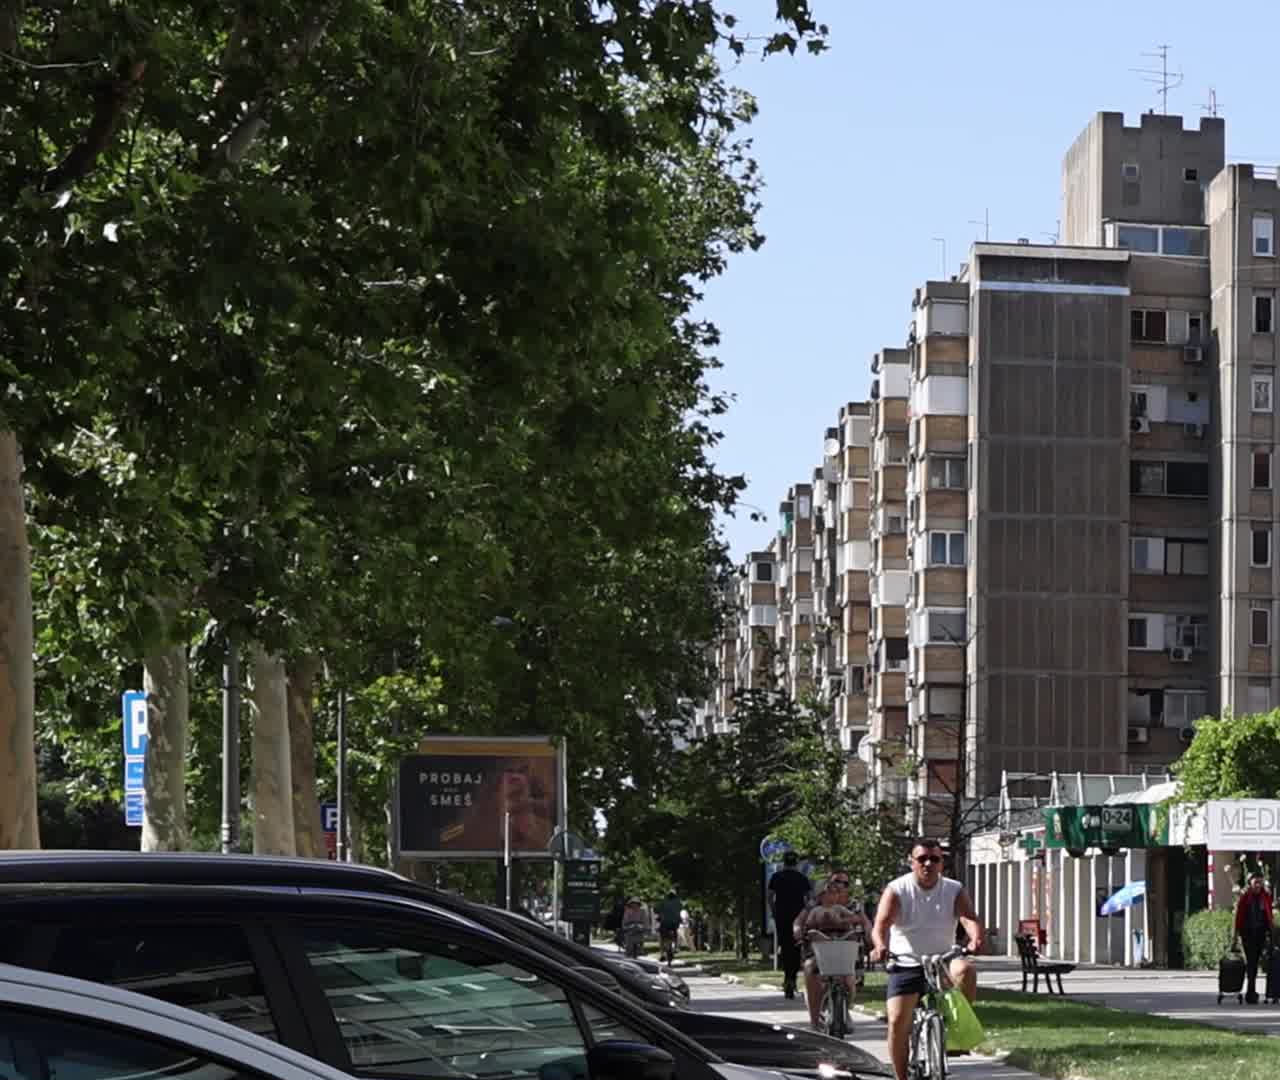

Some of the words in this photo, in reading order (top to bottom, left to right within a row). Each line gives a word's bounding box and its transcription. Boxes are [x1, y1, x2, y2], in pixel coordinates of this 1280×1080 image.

[418, 772, 483, 785] PROBAJ
[430, 792, 473, 806] SMEŠ
[1103, 809, 1131, 825] 0-24
